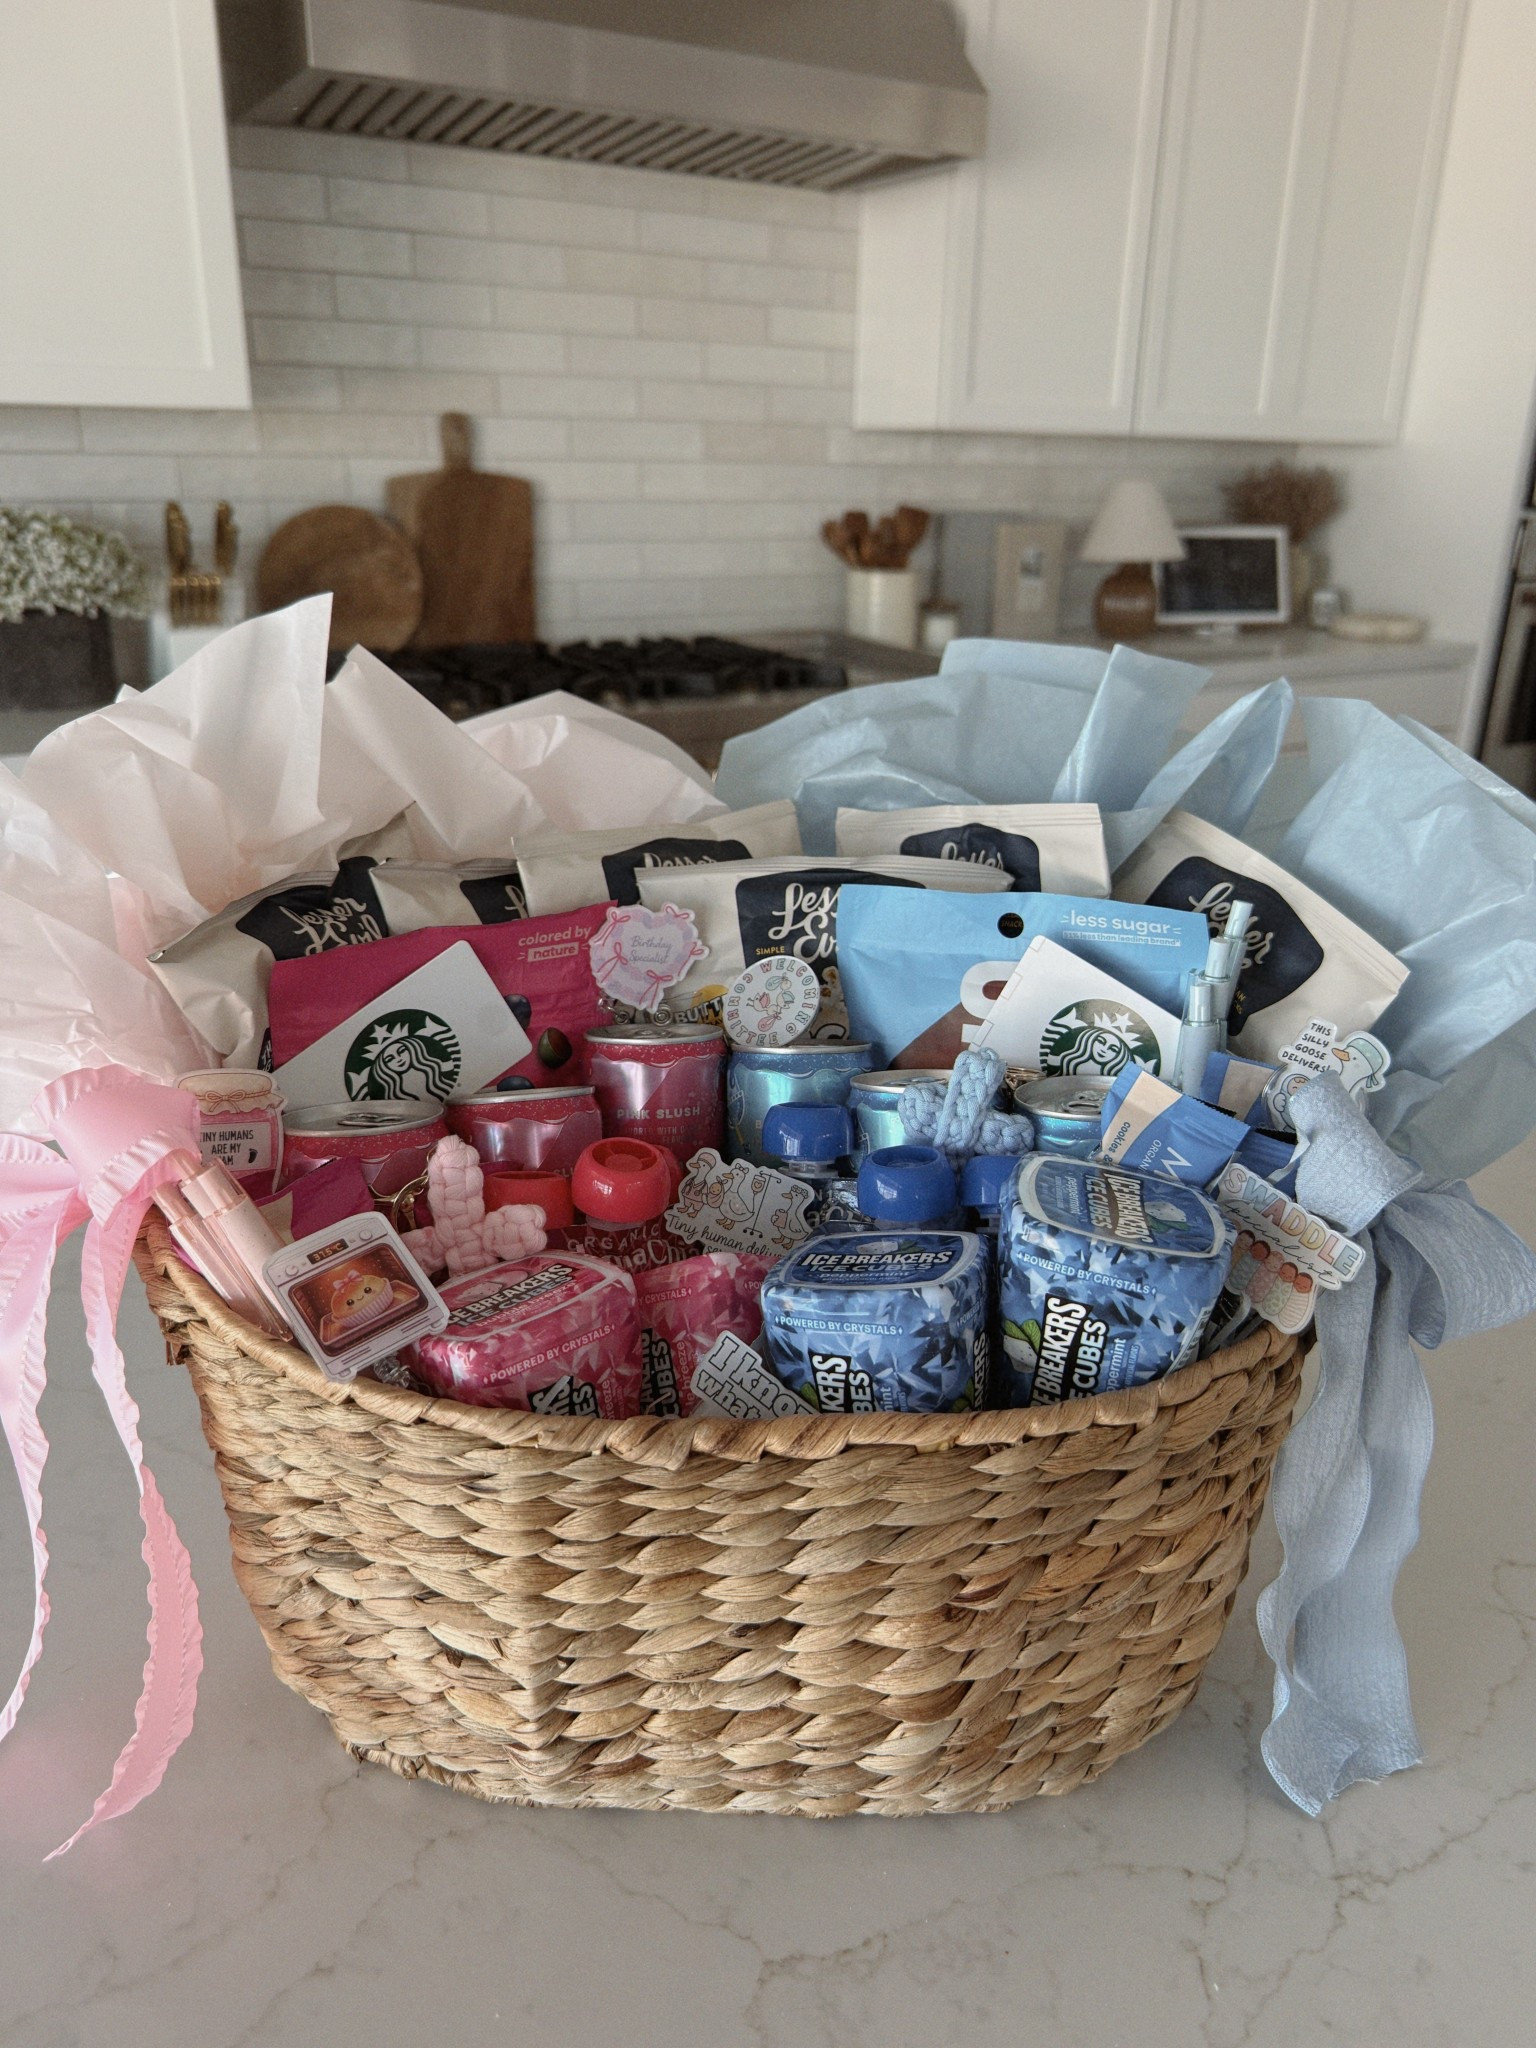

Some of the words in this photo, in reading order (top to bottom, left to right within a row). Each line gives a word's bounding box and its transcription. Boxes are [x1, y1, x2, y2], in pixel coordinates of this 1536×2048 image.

[768, 883, 841, 939] Les
[1071, 910, 1108, 928] less
[1111, 918, 1171, 935] sugar
[518, 928, 572, 947] colored
[575, 925, 592, 940] by
[631, 935, 673, 957] Birthday
[793, 907, 838, 964] Ev
[1080, 932, 1096, 941] less
[1097, 932, 1117, 941] than
[1118, 934, 1150, 944] leading
[533, 944, 576, 959] nature
[629, 949, 669, 965] Specialist
[755, 946, 785, 955] SIMPLE
[674, 996, 722, 1023] BUTT
[727, 973, 779, 1046] COMMITTEE
[760, 958, 817, 1034] WELCOMING
[1302, 1033, 1329, 1048] SILLY
[1311, 1022, 1331, 1036] THIS
[1295, 1043, 1327, 1060] GOOSE
[617, 1108, 650, 1119] PINK
[656, 1106, 700, 1119] SLUSH
[211, 1143, 228, 1155] ARE
[230, 1143, 241, 1153] MY
[219, 1130, 254, 1142] HUMANS
[1109, 1121, 1131, 1153] cookies
[1104, 1173, 1141, 1194] ICE
[1088, 1195, 1112, 1229] CUBES
[1115, 1193, 1154, 1243] BREAKERS
[1224, 1167, 1359, 1277] SWADDLE
[567, 1224, 660, 1252] ORGANIC
[669, 1215, 698, 1240] Tiny
[701, 1226, 744, 1251] human
[313, 1248, 332, 1261] 375
[801, 1254, 839, 1266] ICE
[841, 1251, 952, 1265] BREAKERS
[810, 1264, 853, 1273] ICE
[854, 1263, 933, 1272] CUBES
[1024, 1253, 1075, 1277] POWERED
[1077, 1269, 1092, 1281] BY
[1094, 1273, 1150, 1293] CRYSTALS
[448, 1308, 473, 1324] CE
[466, 1264, 573, 1312] BREAKERS
[457, 1308, 500, 1326] ICE
[499, 1275, 573, 1309] CUBES
[645, 1287, 687, 1304] CRYSTALS
[780, 1316, 826, 1330] POWERED
[828, 1321, 841, 1332] BY
[843, 1322, 897, 1335] CRYSTALS
[490, 1354, 545, 1383] POWERED
[547, 1345, 561, 1361] BY
[562, 1325, 611, 1352] CRYSTALS
[1035, 1297, 1086, 1395] BREAKERS
[1073, 1320, 1106, 1389] CUBES
[677, 1341, 690, 1390] breeze
[709, 1335, 739, 1371] I
[729, 1351, 815, 1415] kno
[812, 1355, 847, 1412] KERS
[851, 1372, 874, 1413] BES
